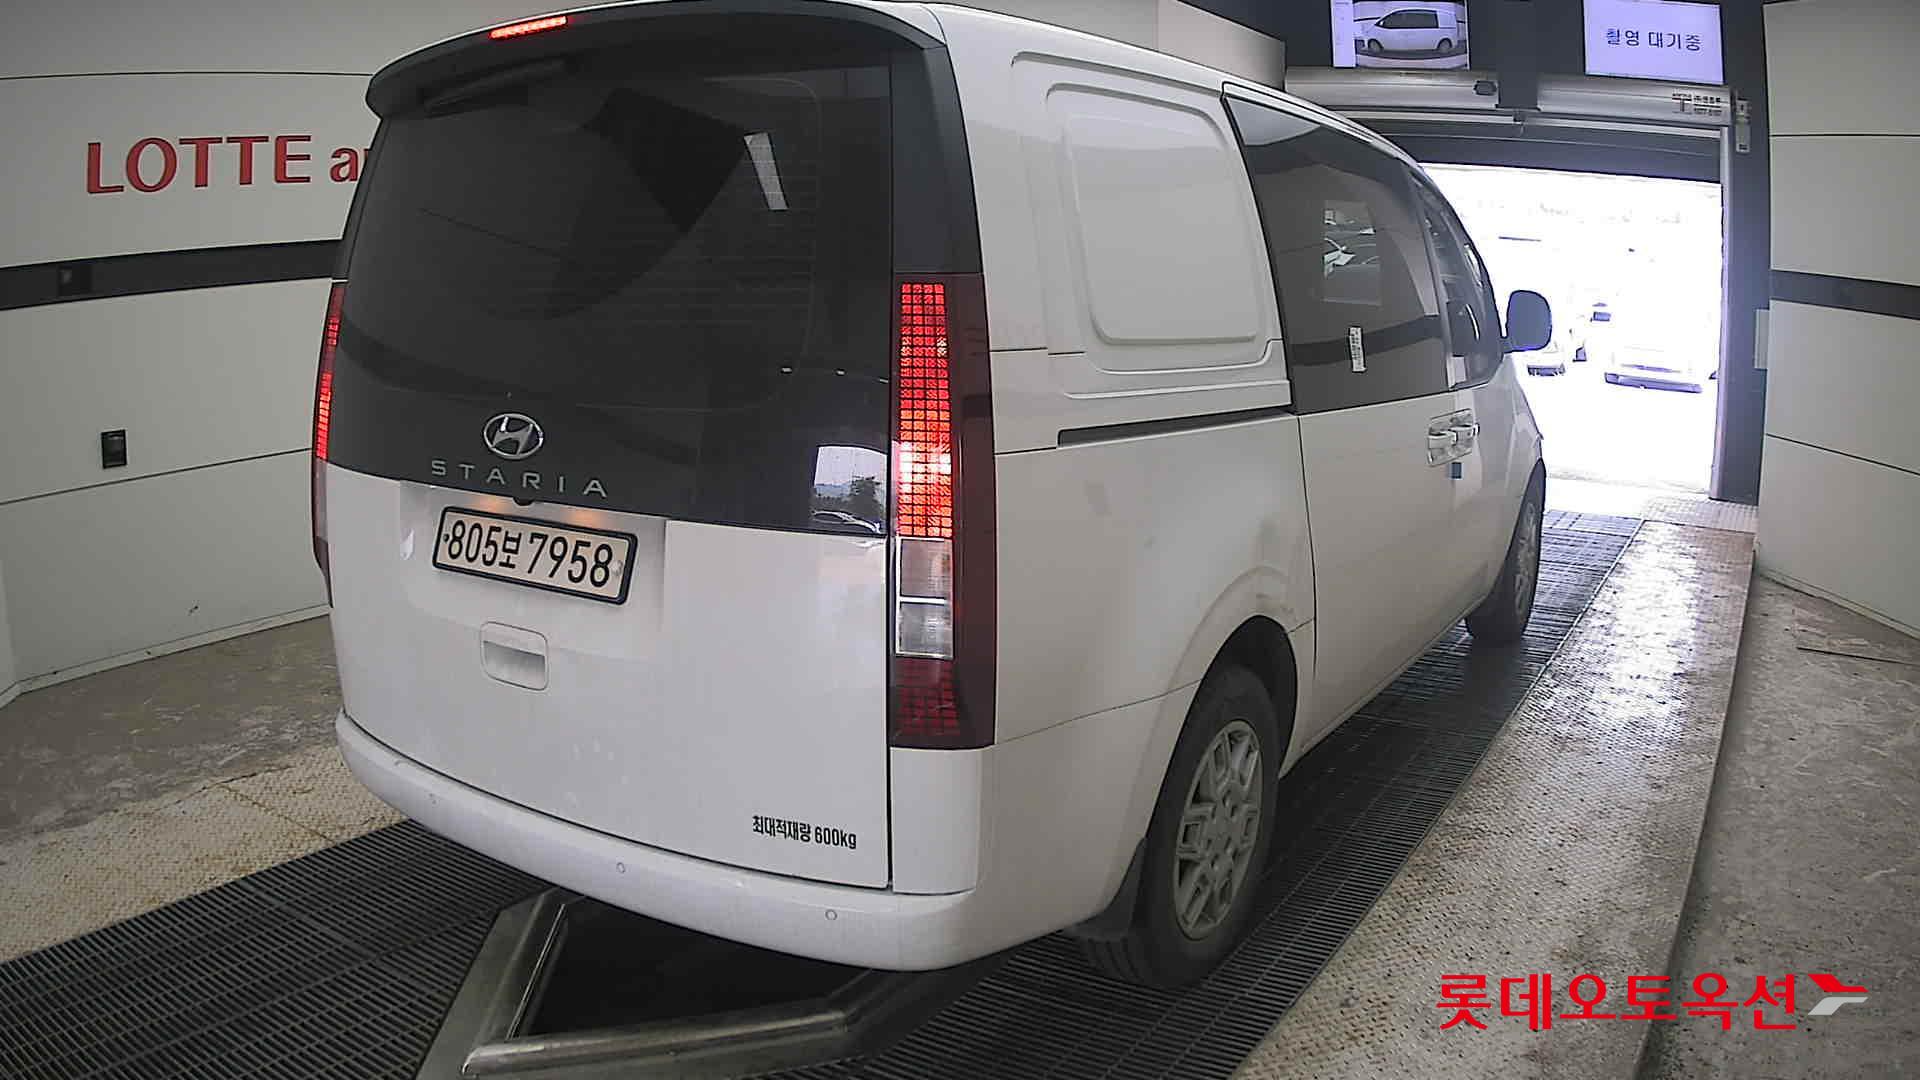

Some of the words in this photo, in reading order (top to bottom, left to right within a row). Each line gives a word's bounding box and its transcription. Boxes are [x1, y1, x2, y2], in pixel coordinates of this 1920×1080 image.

[1647, 31, 1702, 52] 대기중
[86, 134, 312, 194] LOTTE
[329, 146, 369, 182] a
[431, 460, 608, 498] STARIA
[752, 815, 811, 842] 최대적재량
[815, 826, 857, 850] 600kg
